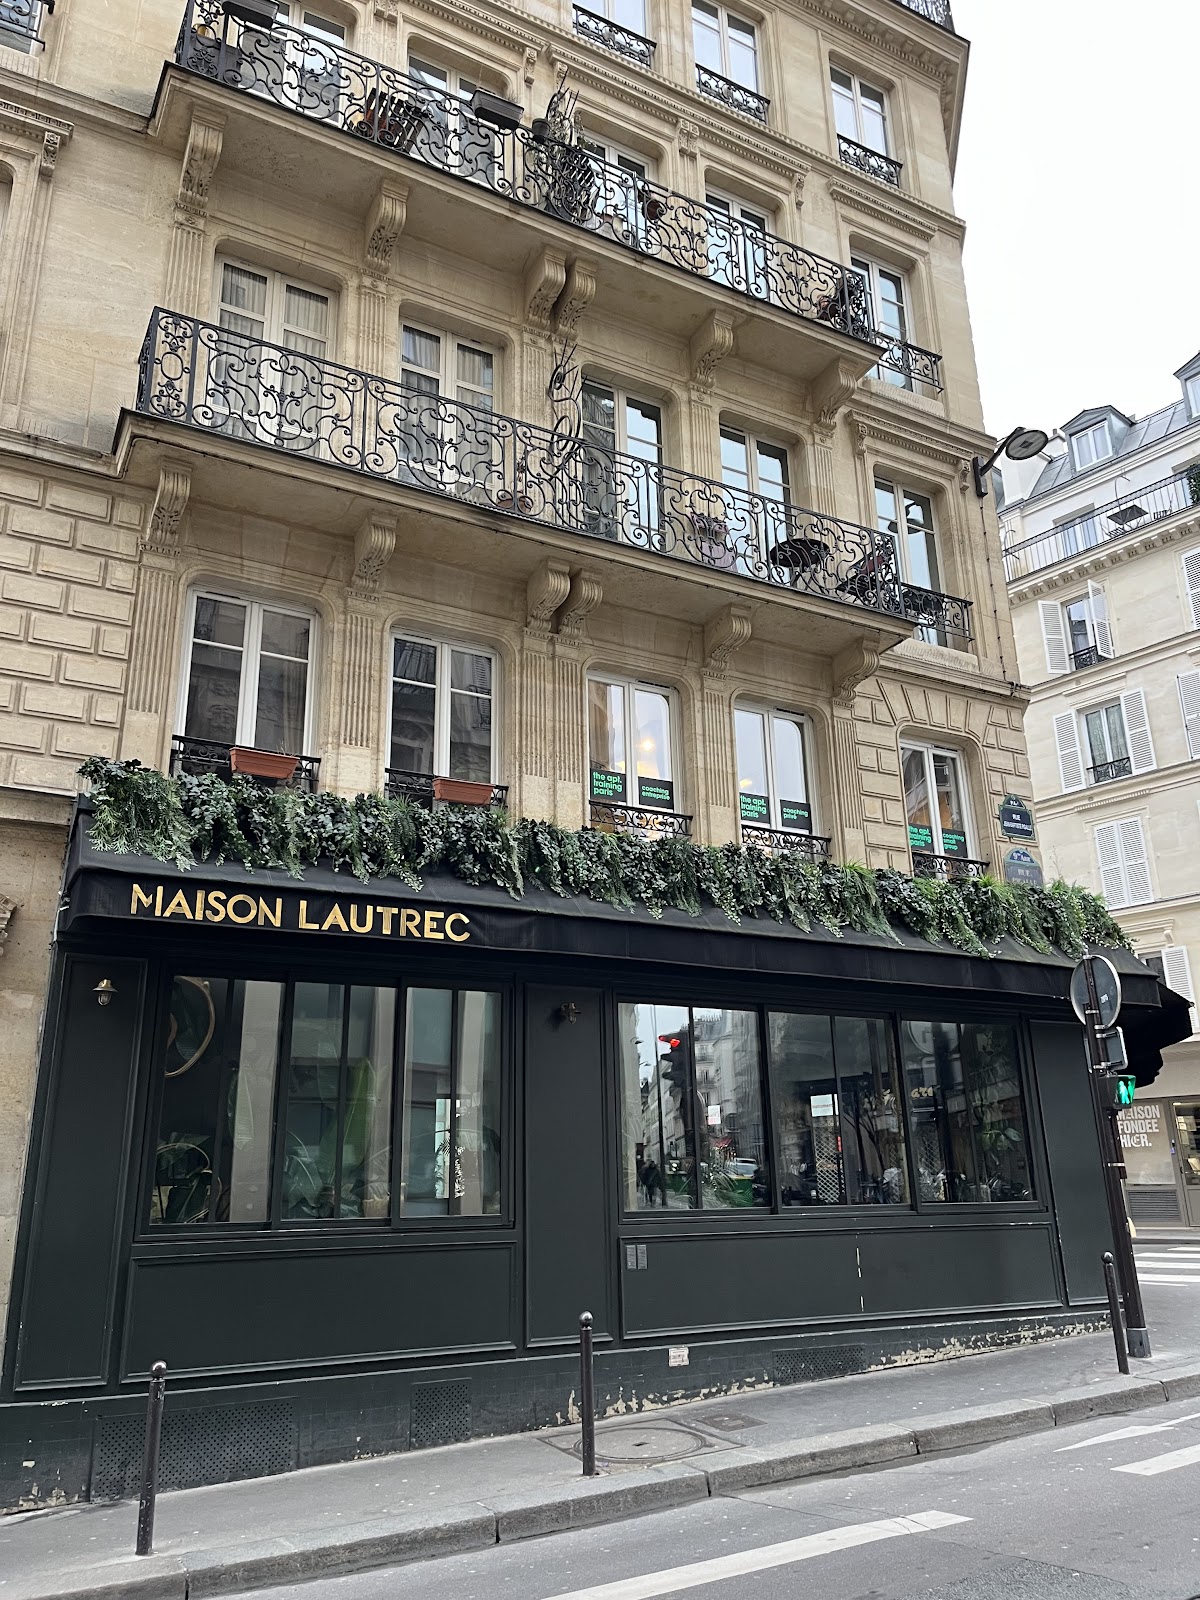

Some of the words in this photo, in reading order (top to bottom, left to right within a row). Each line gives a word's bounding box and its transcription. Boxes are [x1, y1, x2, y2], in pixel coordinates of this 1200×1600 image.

[593, 772, 606, 781] the
[606, 775, 622, 784] apt.
[593, 779, 623, 792] training
[641, 785, 669, 796] coaching
[593, 787, 613, 796] paris
[642, 791, 670, 801] entreprise
[740, 795, 751, 804] the
[752, 798, 766, 806] apt.
[740, 803, 767, 814] training
[741, 810, 759, 818] paris
[782, 808, 808, 818] coaching
[130, 883, 283, 928] MAISON
[298, 899, 471, 942] LAUTREC
